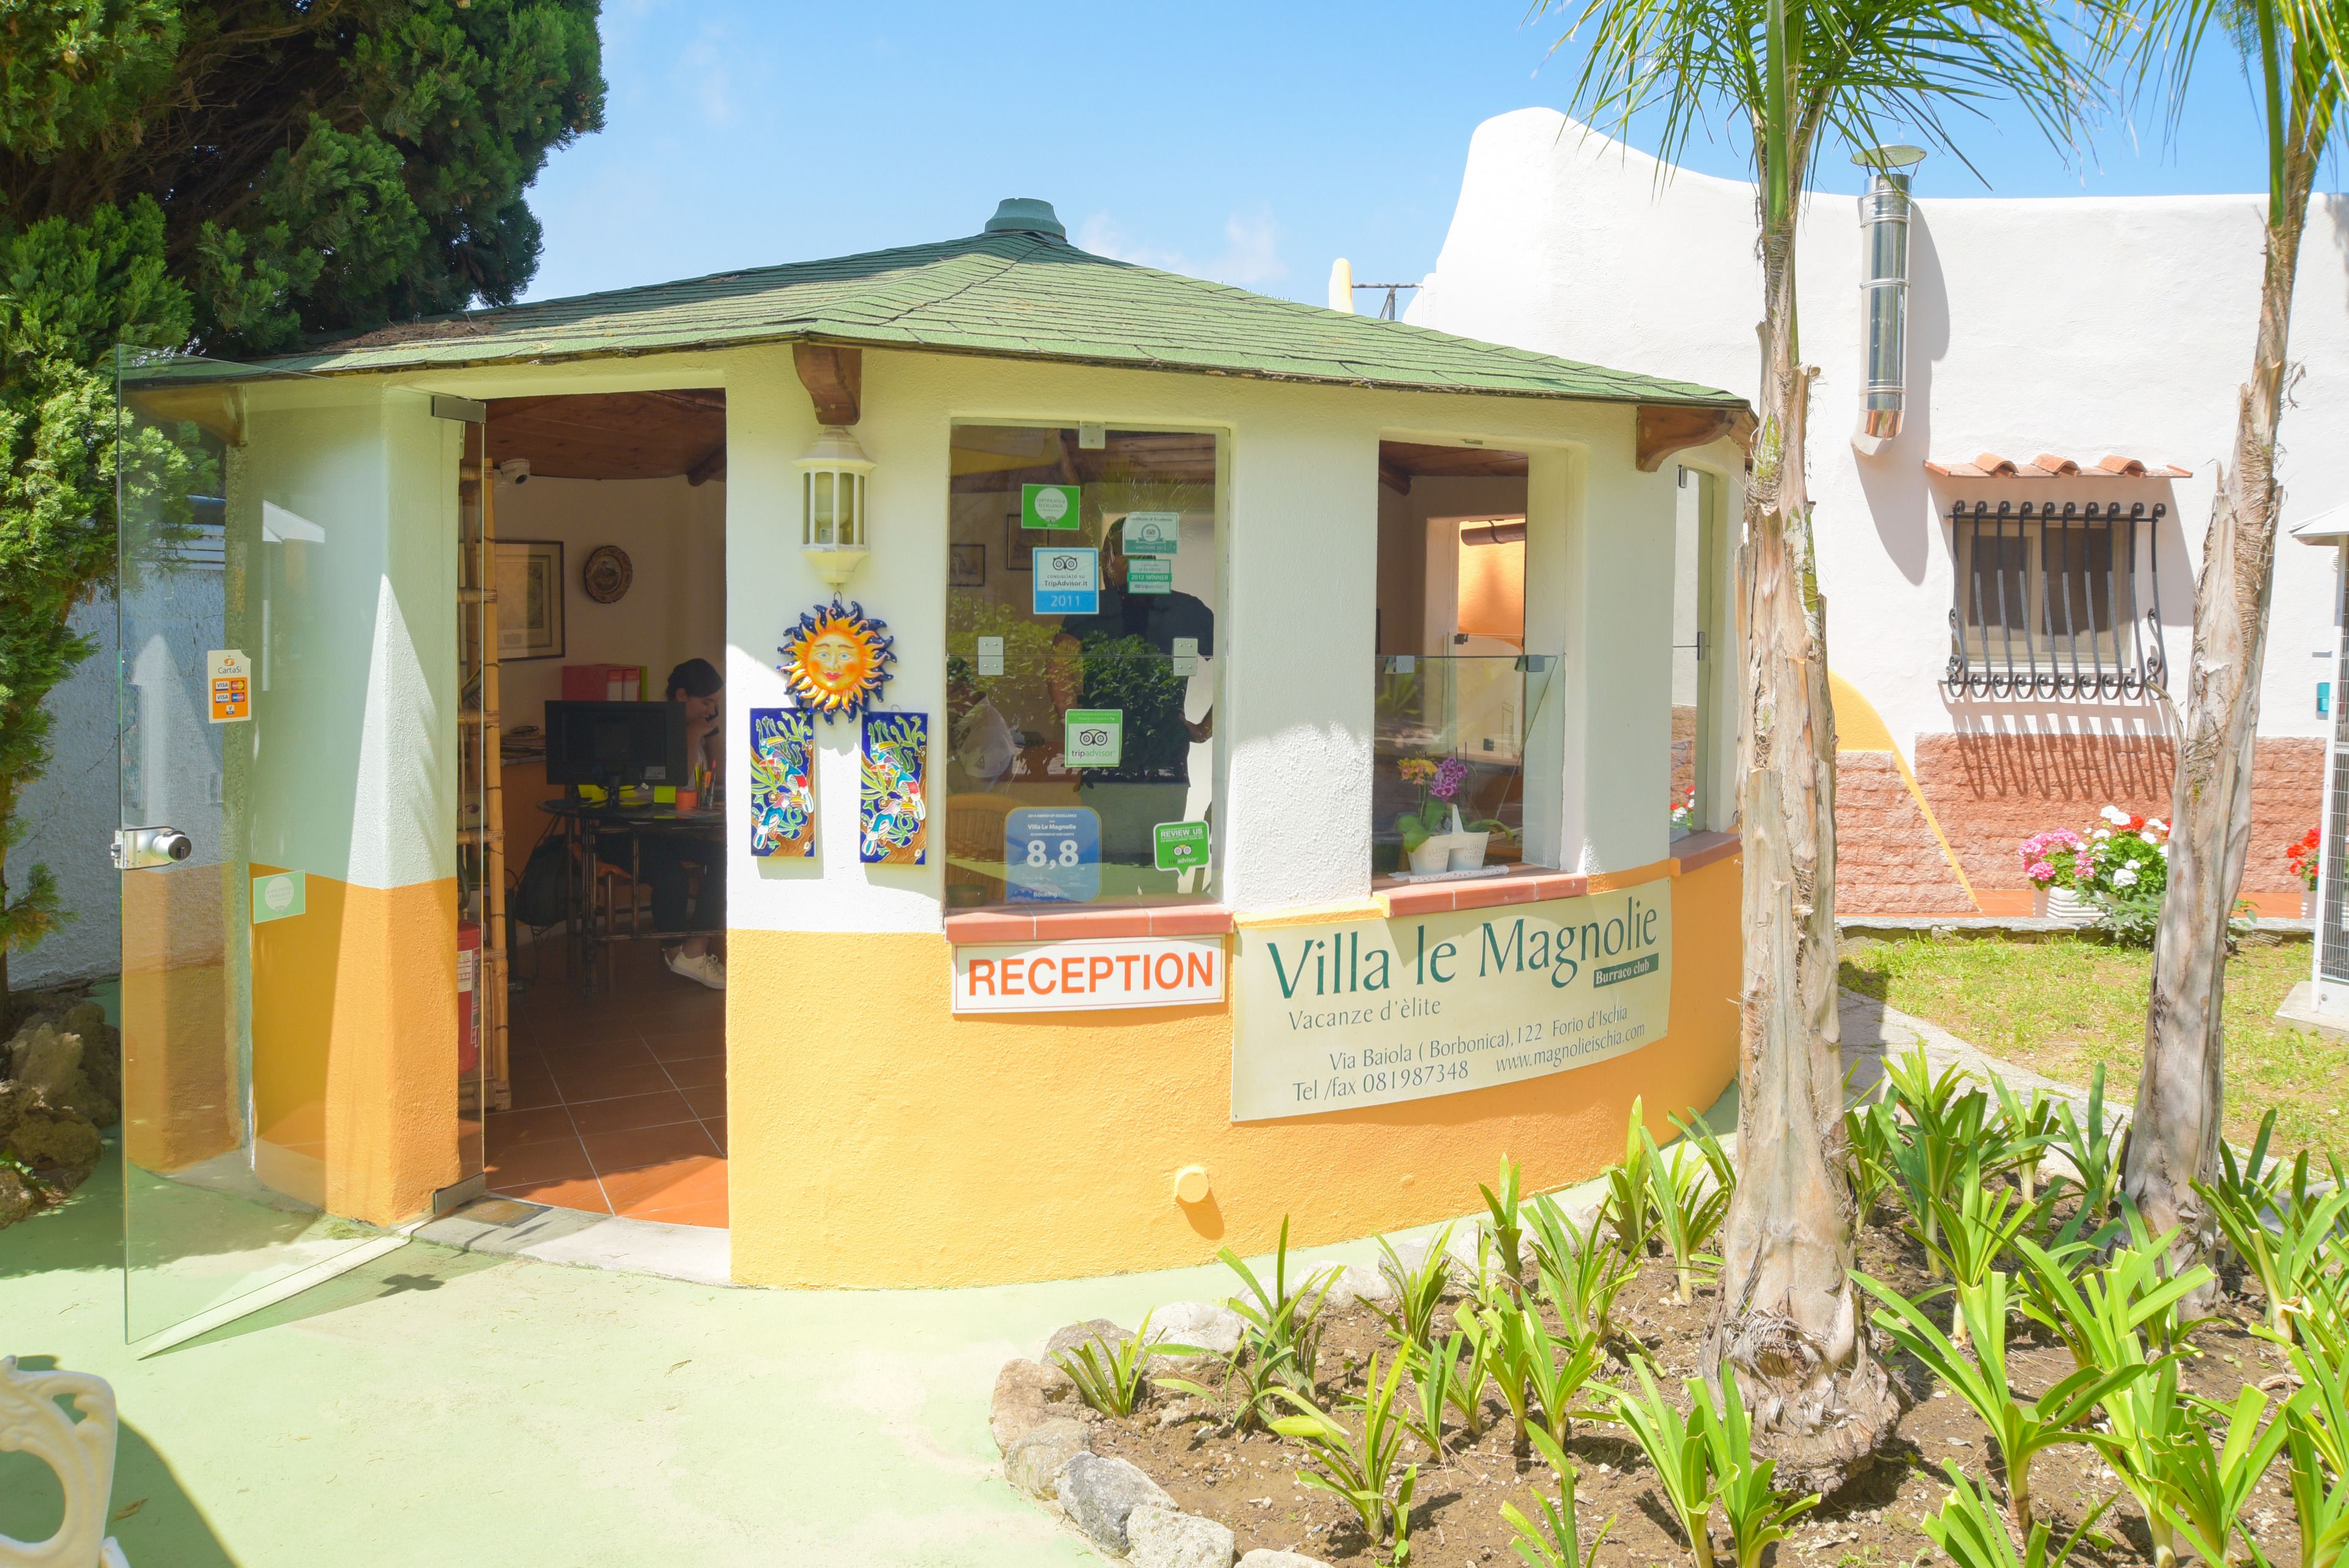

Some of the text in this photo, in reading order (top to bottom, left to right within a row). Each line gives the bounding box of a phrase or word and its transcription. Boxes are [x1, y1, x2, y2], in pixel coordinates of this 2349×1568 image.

[1051, 595, 1080, 607] 2011
[218, 666, 242, 674] CartaSi
[1072, 749, 1113, 759] tripadvisor
[1160, 829, 1190, 838] REVIEW
[1026, 839, 1079, 870] 8,8
[1266, 896, 1657, 999] Villa le Magnolie
[968, 951, 1213, 997] RECEPTION
[1595, 959, 1650, 986] Burraco club
[1288, 997, 1441, 1031] Vacanze d'èlite
[1329, 1052, 1356, 1071] Via
[1363, 1043, 1412, 1067] Baiola
[1553, 1017, 1584, 1037] Forio
[1587, 1005, 1627, 1029] d'Ischia
[1293, 1023, 1645, 1101] Tel /fax 081987348 www.magnolieischia.com
